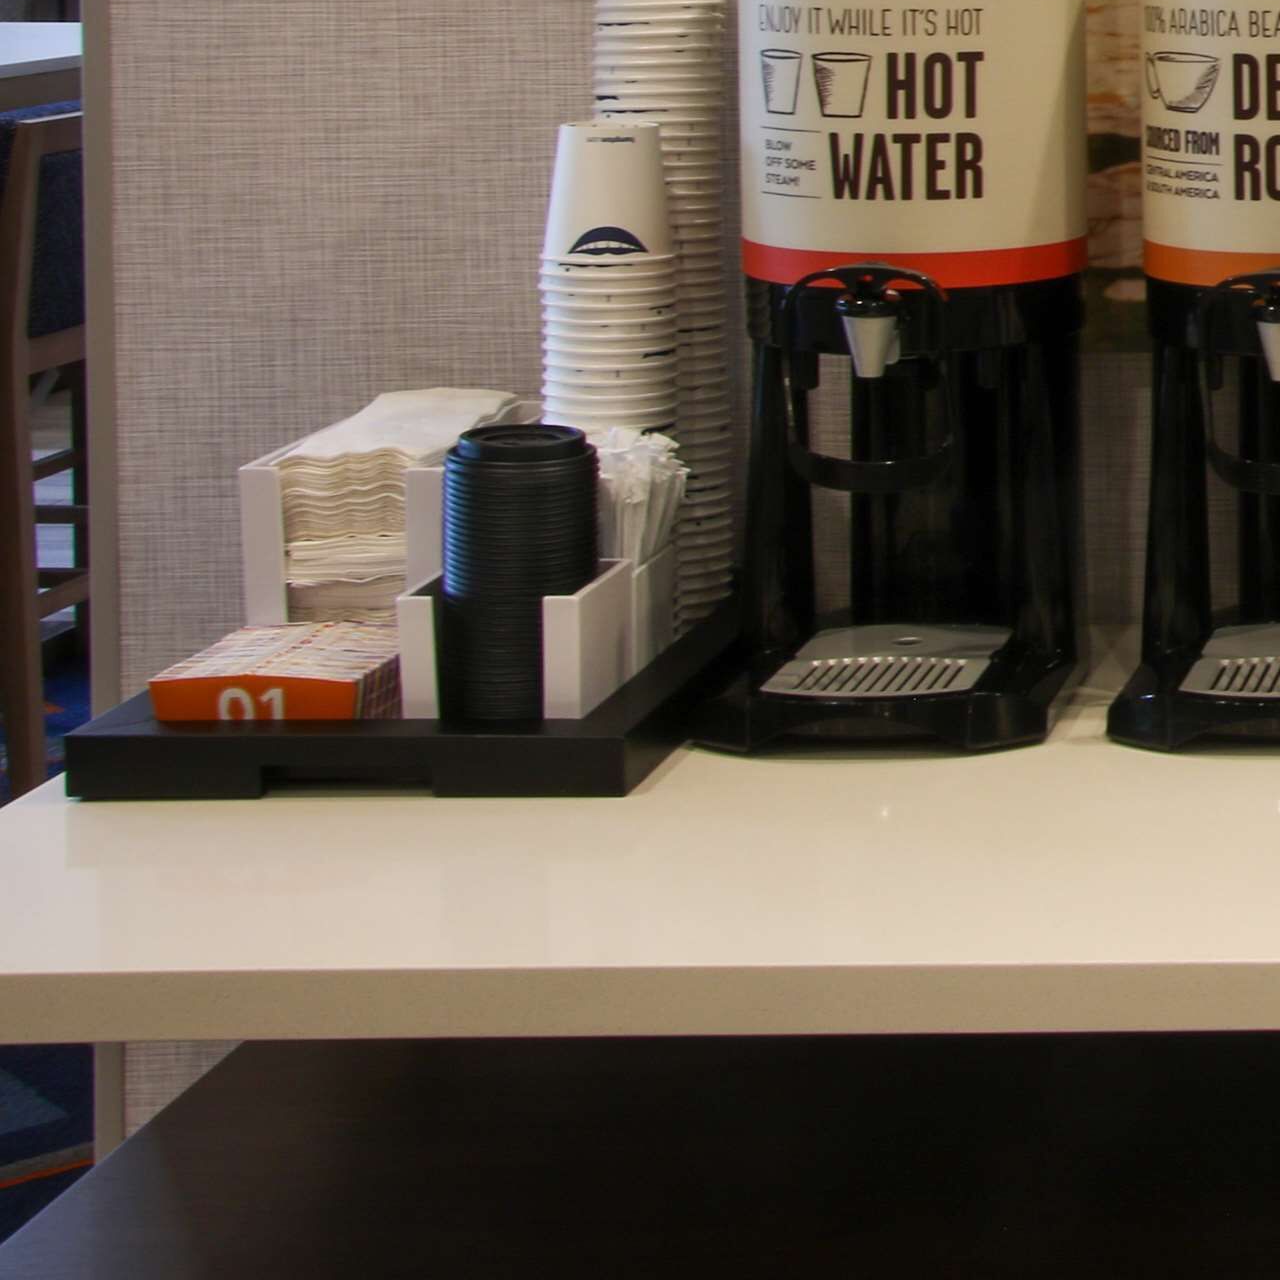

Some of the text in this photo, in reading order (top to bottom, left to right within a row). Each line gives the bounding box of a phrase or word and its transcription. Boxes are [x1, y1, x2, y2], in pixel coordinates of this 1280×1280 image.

[758, 3, 984, 37] ENJOY IT WHILE IT'S HOT
[1169, 7, 1241, 37] ARABICA
[886, 51, 985, 120] HOT
[1184, 128, 1220, 156] FROM
[784, 158, 817, 171] SOME
[828, 132, 984, 201] WATER
